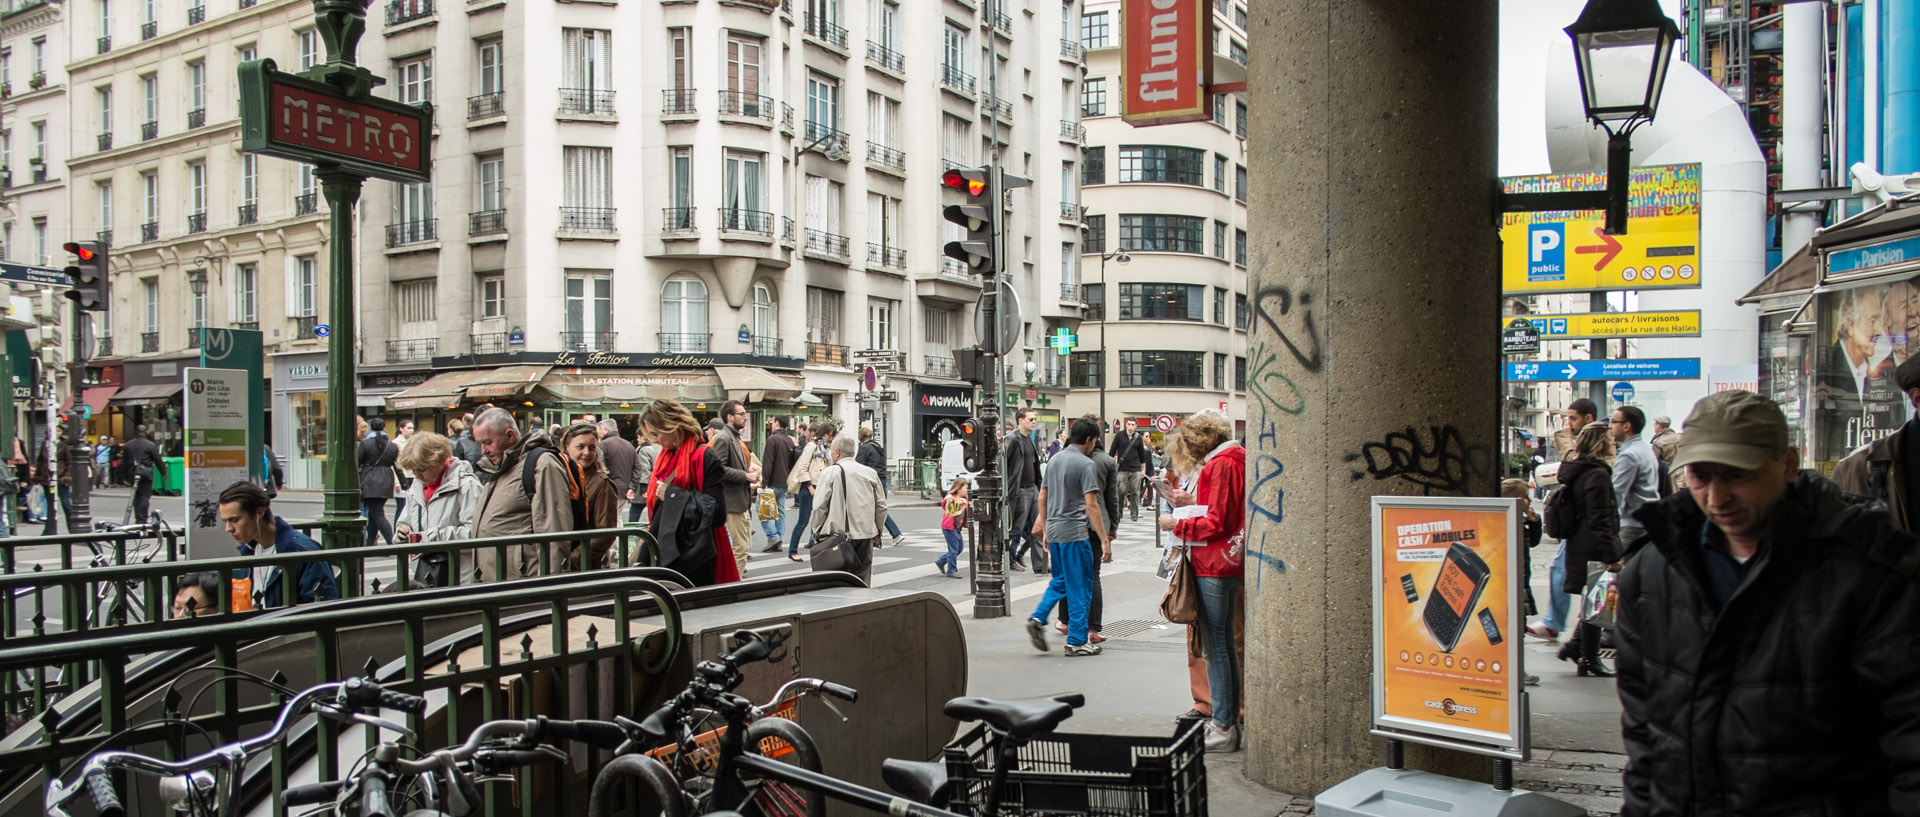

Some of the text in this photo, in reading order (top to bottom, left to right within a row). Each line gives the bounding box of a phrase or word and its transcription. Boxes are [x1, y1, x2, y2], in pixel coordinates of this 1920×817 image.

[283, 94, 412, 159] METRO
[1531, 229, 1560, 262] P
[1861, 248, 1904, 266] Parisien
[1531, 264, 1560, 274] public
[1592, 315, 1629, 324] autocars
[1637, 314, 1680, 323] livraisons
[1592, 325, 1614, 334] accès
[1615, 326, 1629, 335] par
[1630, 325, 1638, 333] la
[1655, 325, 1669, 333] des
[1671, 323, 1697, 332] Halles
[554, 352, 576, 366] La
[586, 352, 630, 365] Station
[289, 365, 321, 376] VISION
[1862, 406, 1875, 428] la
[1397, 520, 1452, 537] OPERATION
[1398, 529, 1476, 547] CASH / MOBILES
